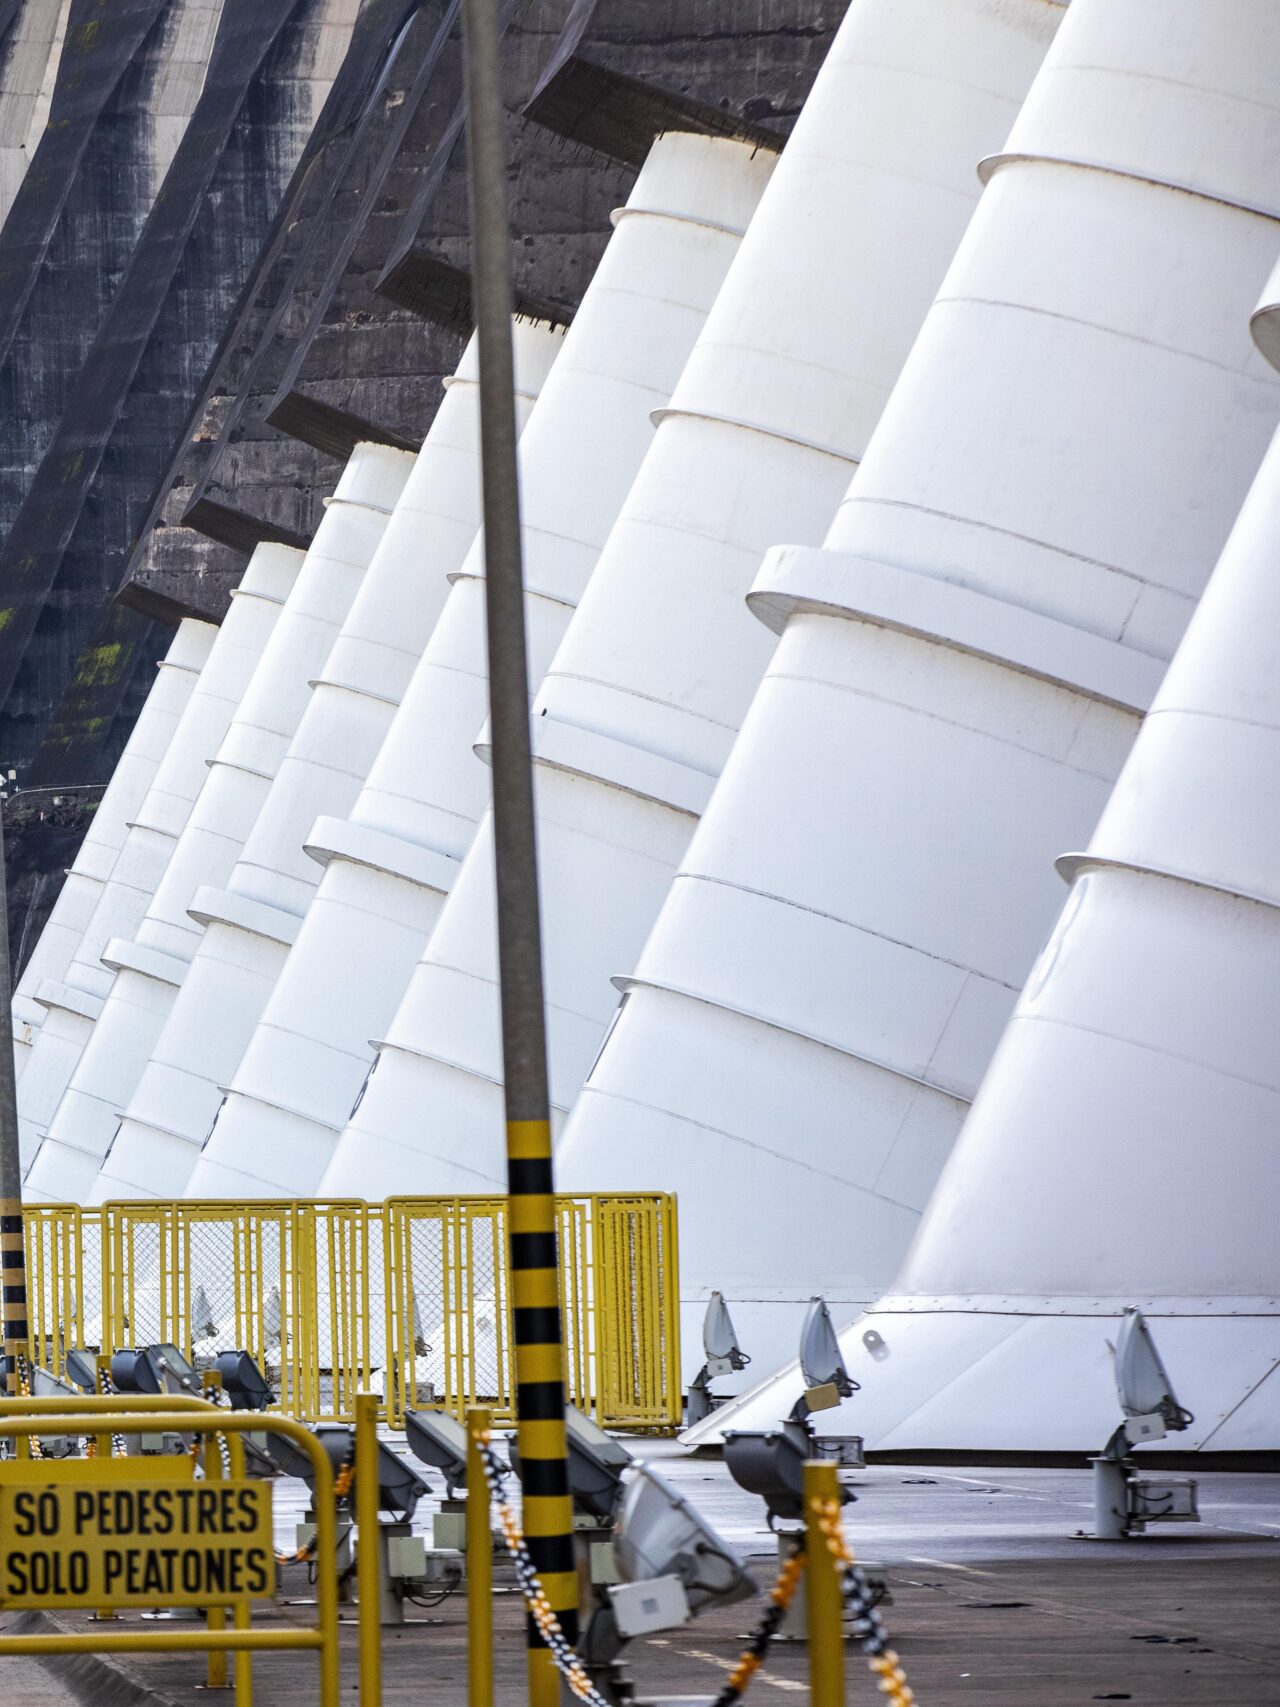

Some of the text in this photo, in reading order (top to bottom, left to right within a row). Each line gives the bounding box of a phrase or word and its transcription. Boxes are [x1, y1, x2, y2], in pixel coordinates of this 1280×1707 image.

[14, 1484, 258, 1536] SÓ PEDESTRES
[7, 1547, 267, 1596] SOLO PEATONES
